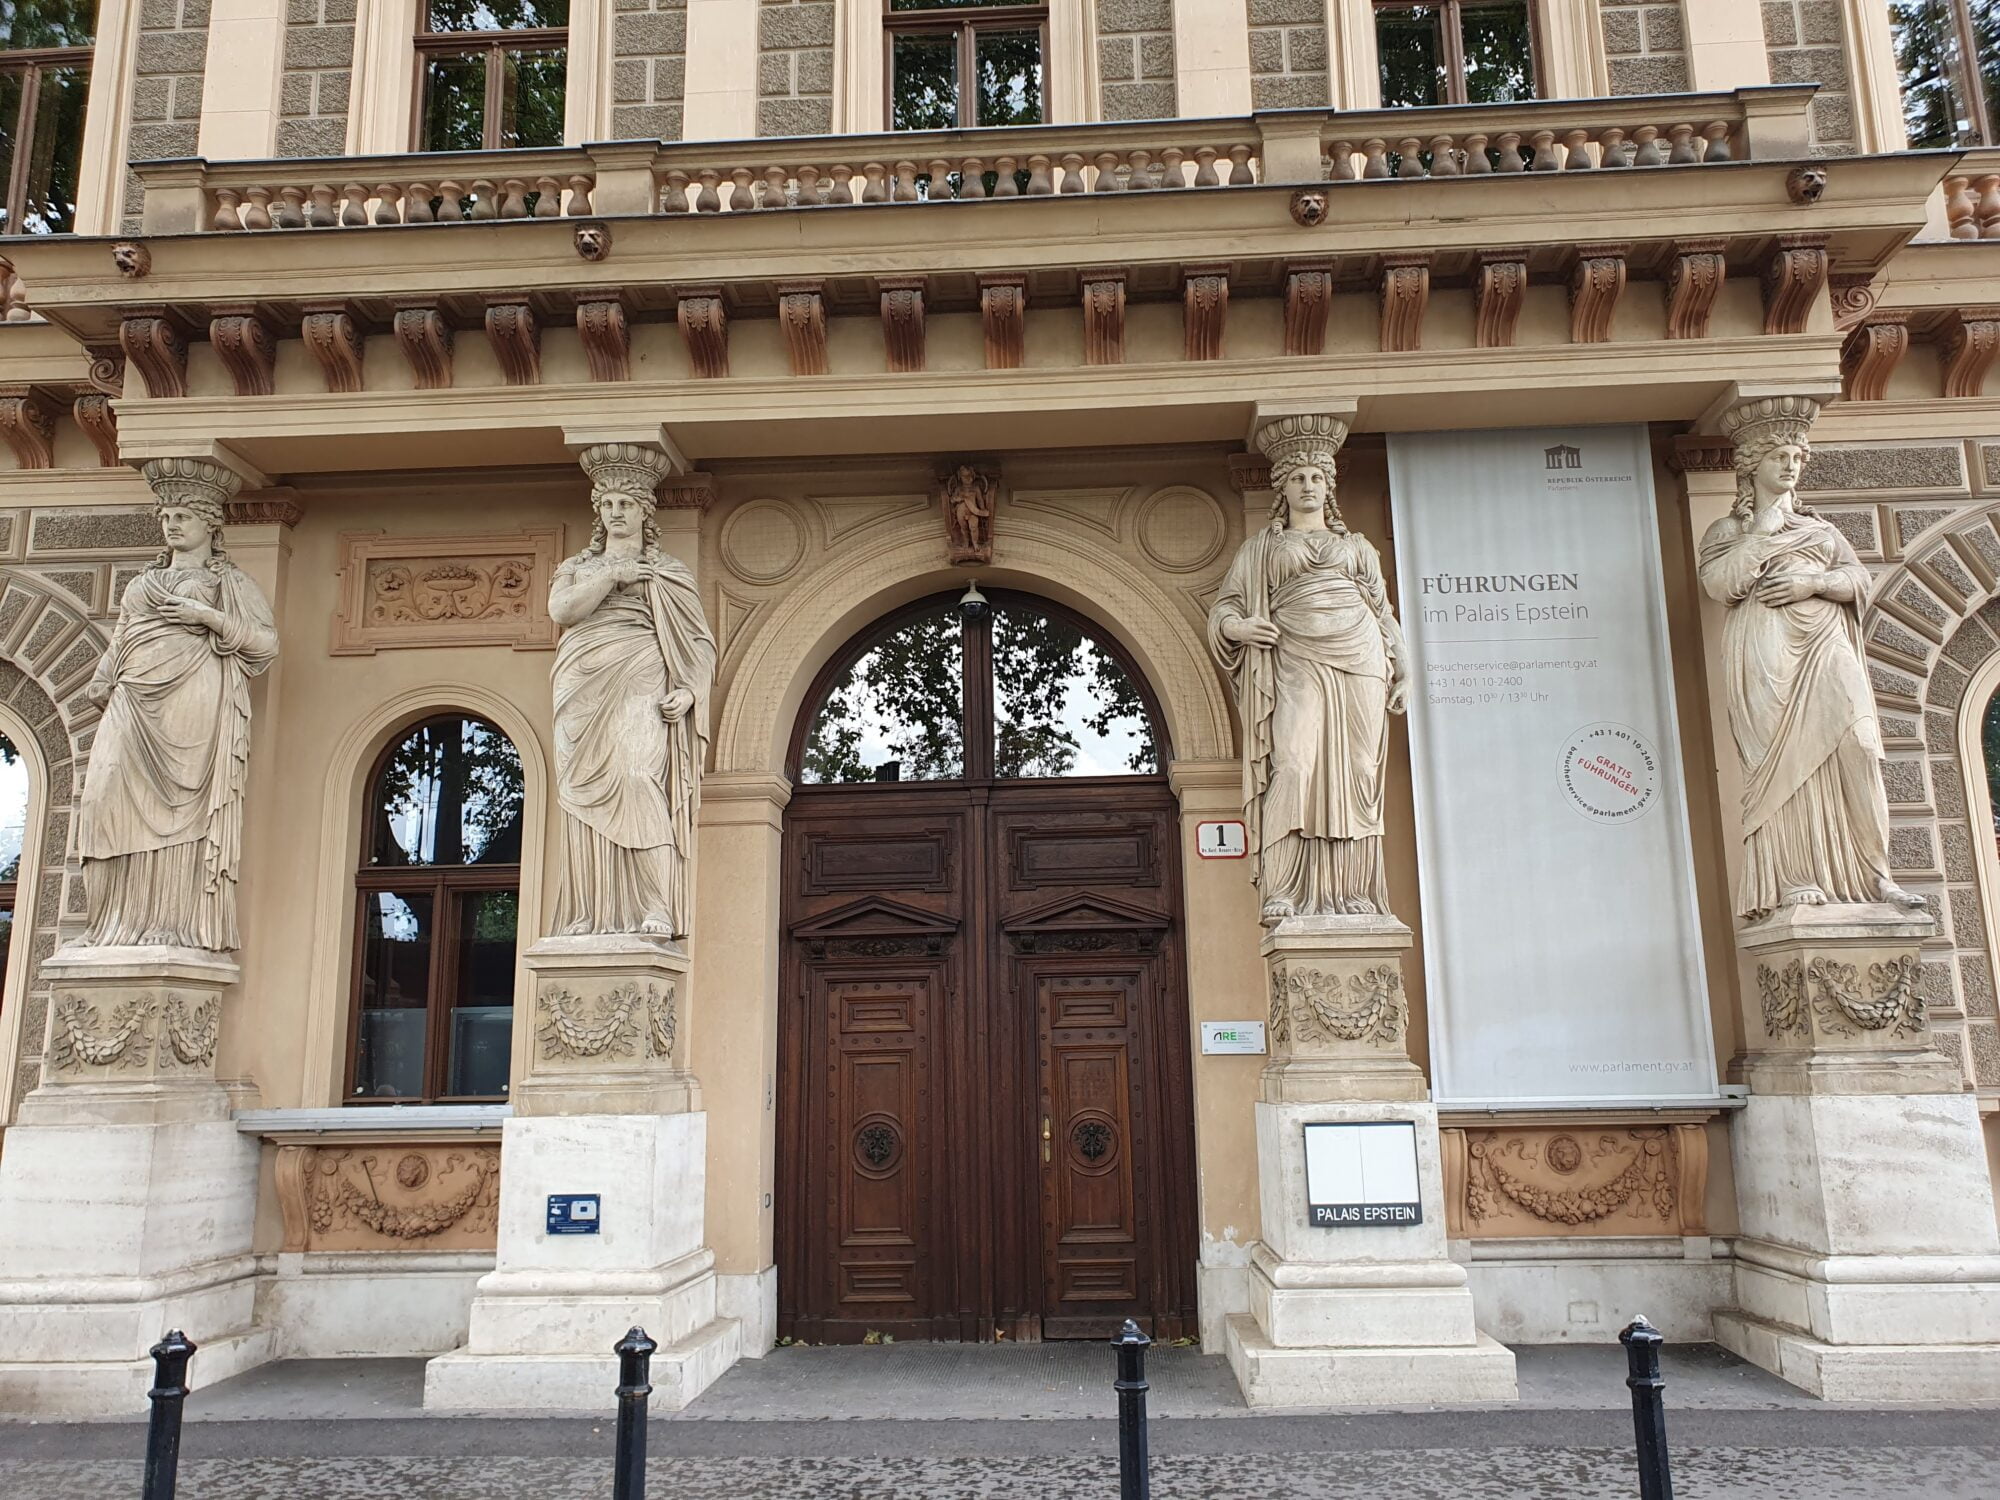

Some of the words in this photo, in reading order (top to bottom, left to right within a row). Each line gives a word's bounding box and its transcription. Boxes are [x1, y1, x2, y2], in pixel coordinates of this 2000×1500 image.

[1585, 475, 1632, 483] ÖSTERREICH
[1422, 573, 1579, 594] FÜHRUNGEN
[1424, 606, 1448, 623] im
[1455, 603, 1509, 622] Palais
[1516, 602, 1589, 625] Epstein
[1427, 659, 1598, 672] besucherservice@parlament.gv.at
[1428, 678, 1448, 688] +43
[1459, 677, 1477, 687] 401
[1482, 676, 1523, 687] 10-2400
[1429, 694, 1475, 705] Samstag,
[1530, 692, 1549, 702] Uhr
[1615, 730, 1631, 741] 401
[1596, 755, 1633, 779] GRATIS
[1577, 758, 1639, 796] FÜHRUNGEN
[1216, 825, 1226, 847] 1
[1568, 1061, 1693, 1073] www.parlament.gv.at
[1317, 1208, 1360, 1221] PALAIS
[1363, 1206, 1415, 1220] EPSTEIN
